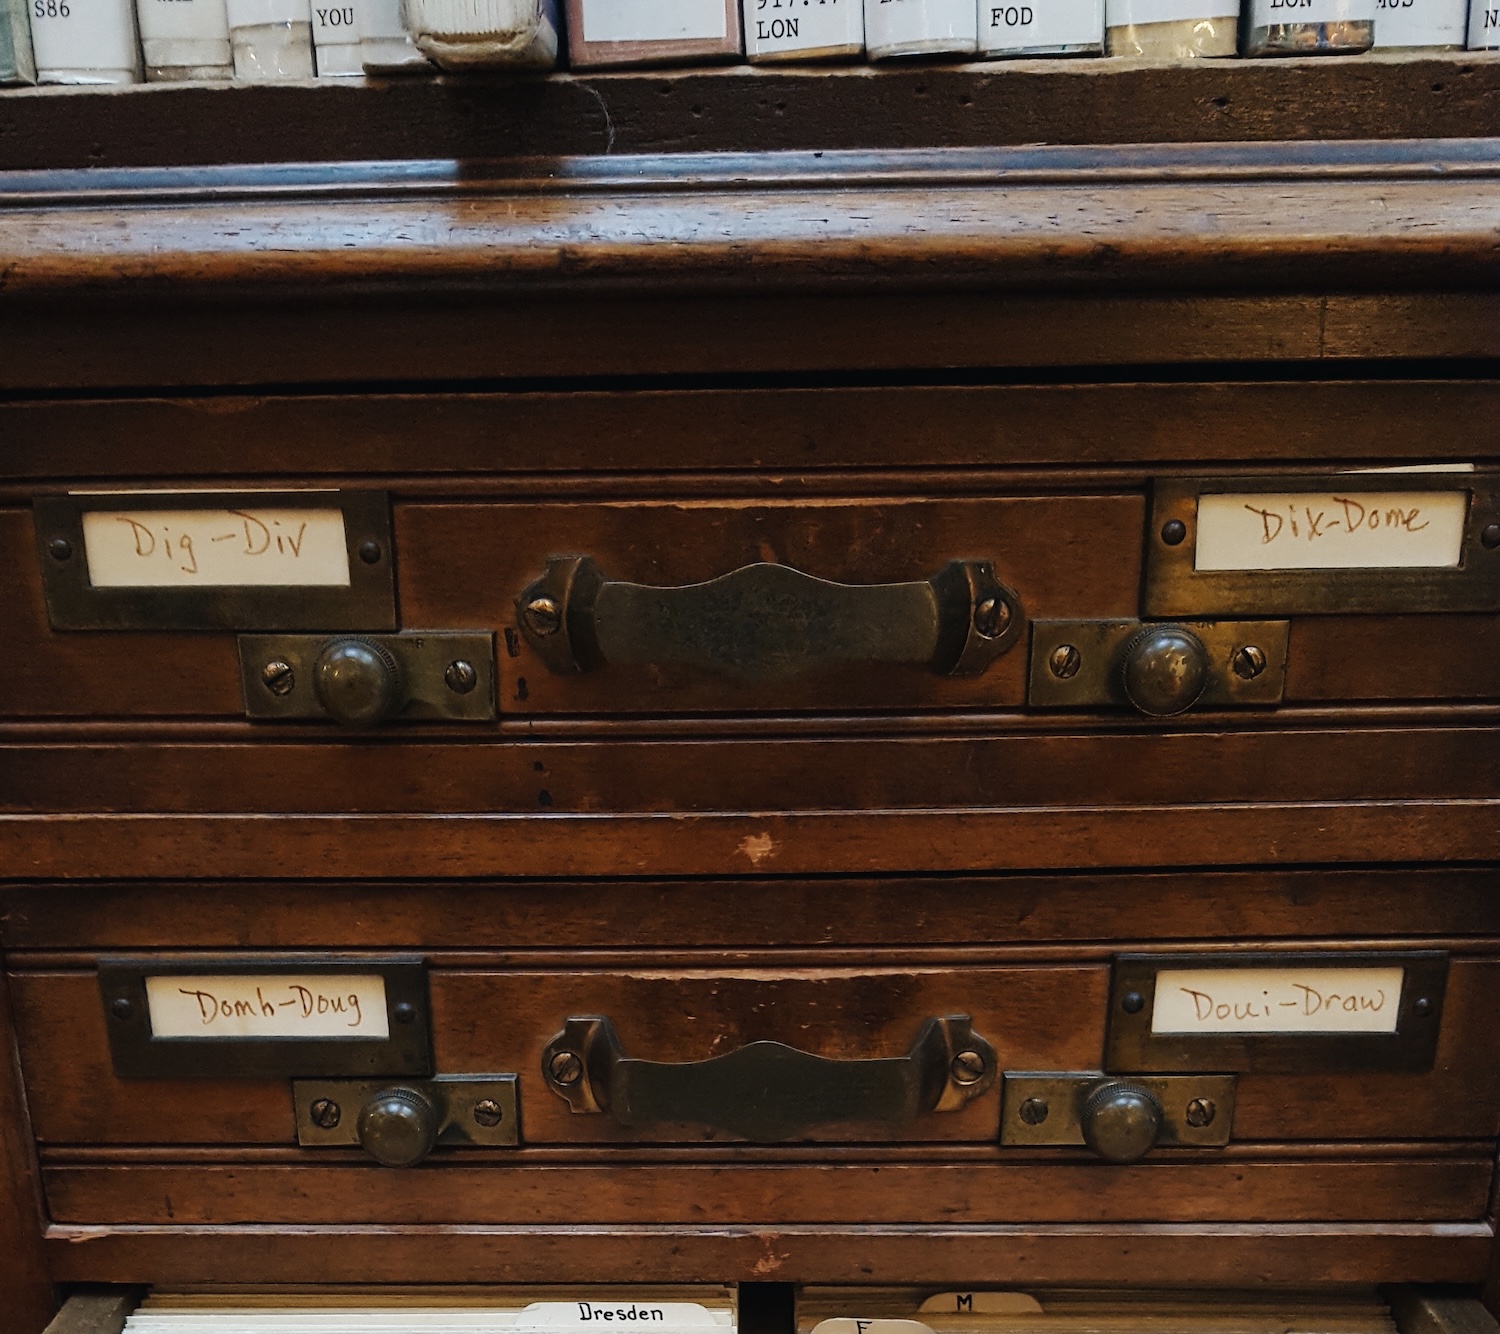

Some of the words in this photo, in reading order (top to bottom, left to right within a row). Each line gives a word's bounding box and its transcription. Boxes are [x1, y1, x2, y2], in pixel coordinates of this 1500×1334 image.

[35, 1, 70, 17] S86
[317, 8, 353, 26] YOU
[991, 7, 1033, 27] FOD
[1484, 10, 1500, 28] N
[757, 19, 799, 39] LON
[1244, 497, 1429, 544] Dix-Dome
[117, 509, 307, 574] Dig-Div
[178, 985, 361, 1027] Domh-Doug
[957, 1294, 972, 1311] M
[578, 1303, 664, 1321] Dresden
[856, 1321, 872, 1334] F
